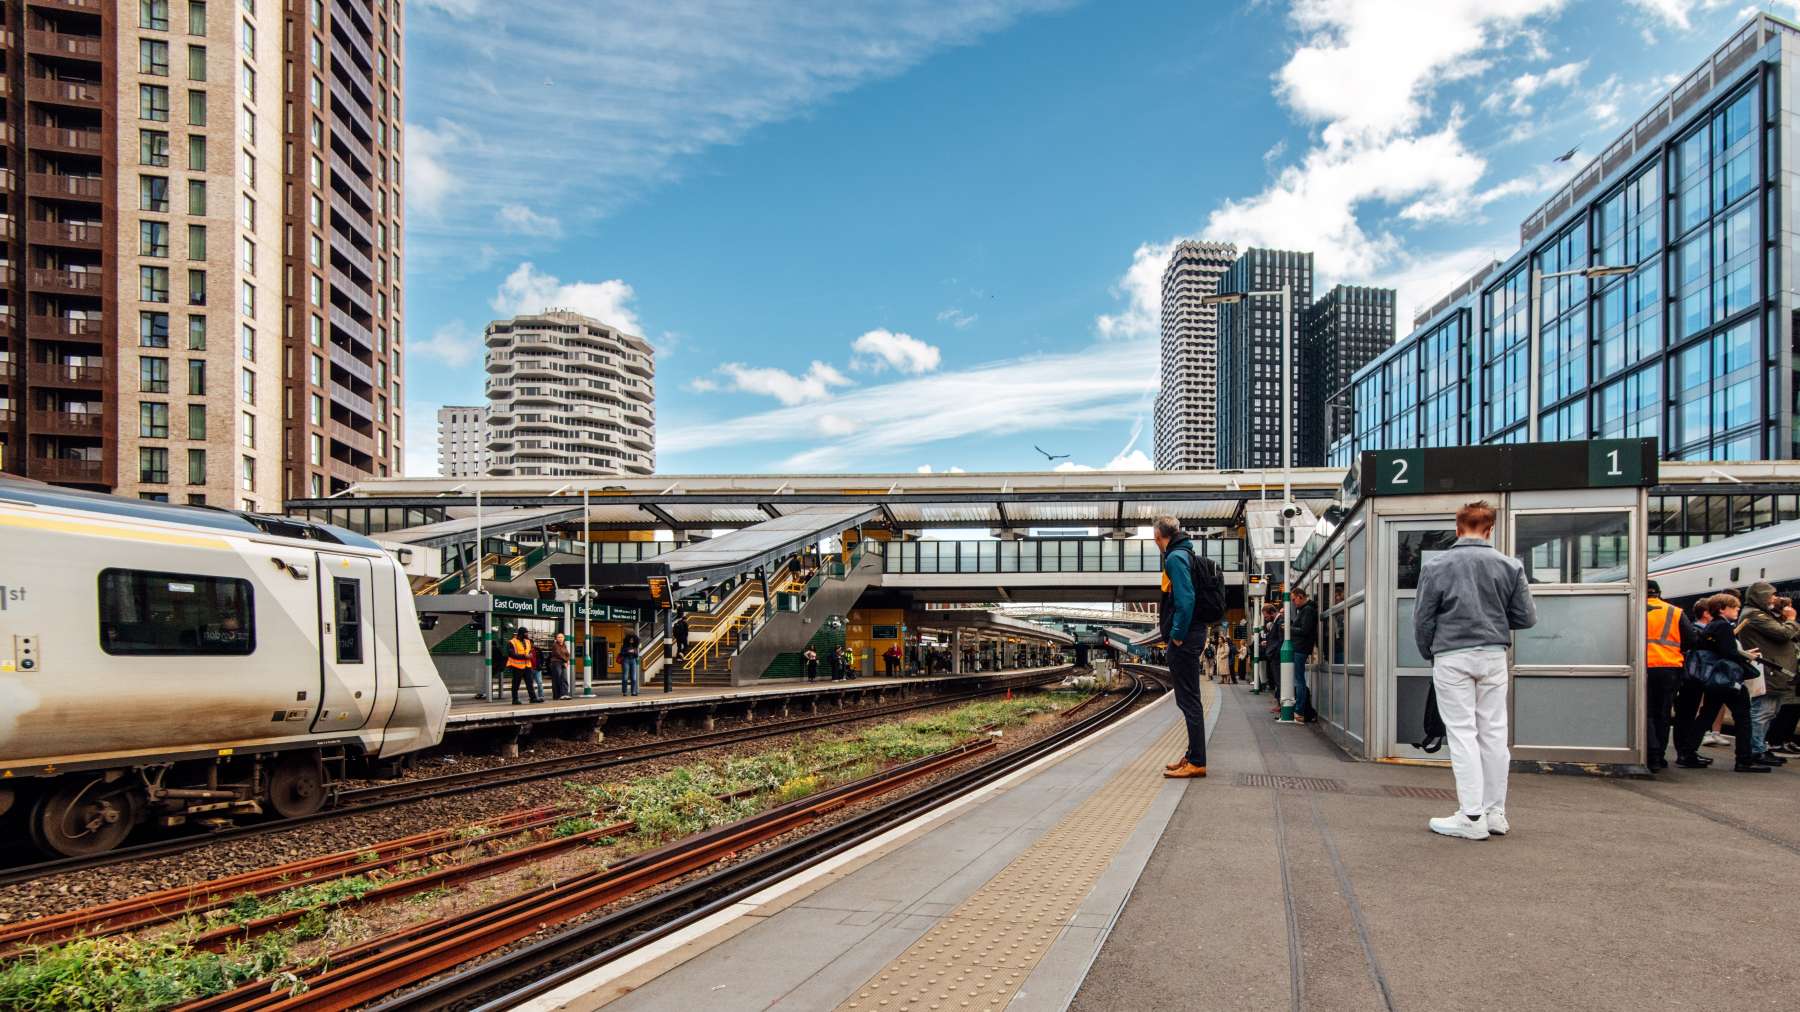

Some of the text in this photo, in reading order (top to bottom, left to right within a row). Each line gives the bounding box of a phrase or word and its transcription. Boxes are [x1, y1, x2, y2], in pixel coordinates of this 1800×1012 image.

[1391, 459, 1408, 484] 2
[1607, 449, 1623, 475] 1
[0, 585, 26, 610] 1st
[494, 599, 533, 612] East Croydon
[541, 603, 564, 613] Platform
